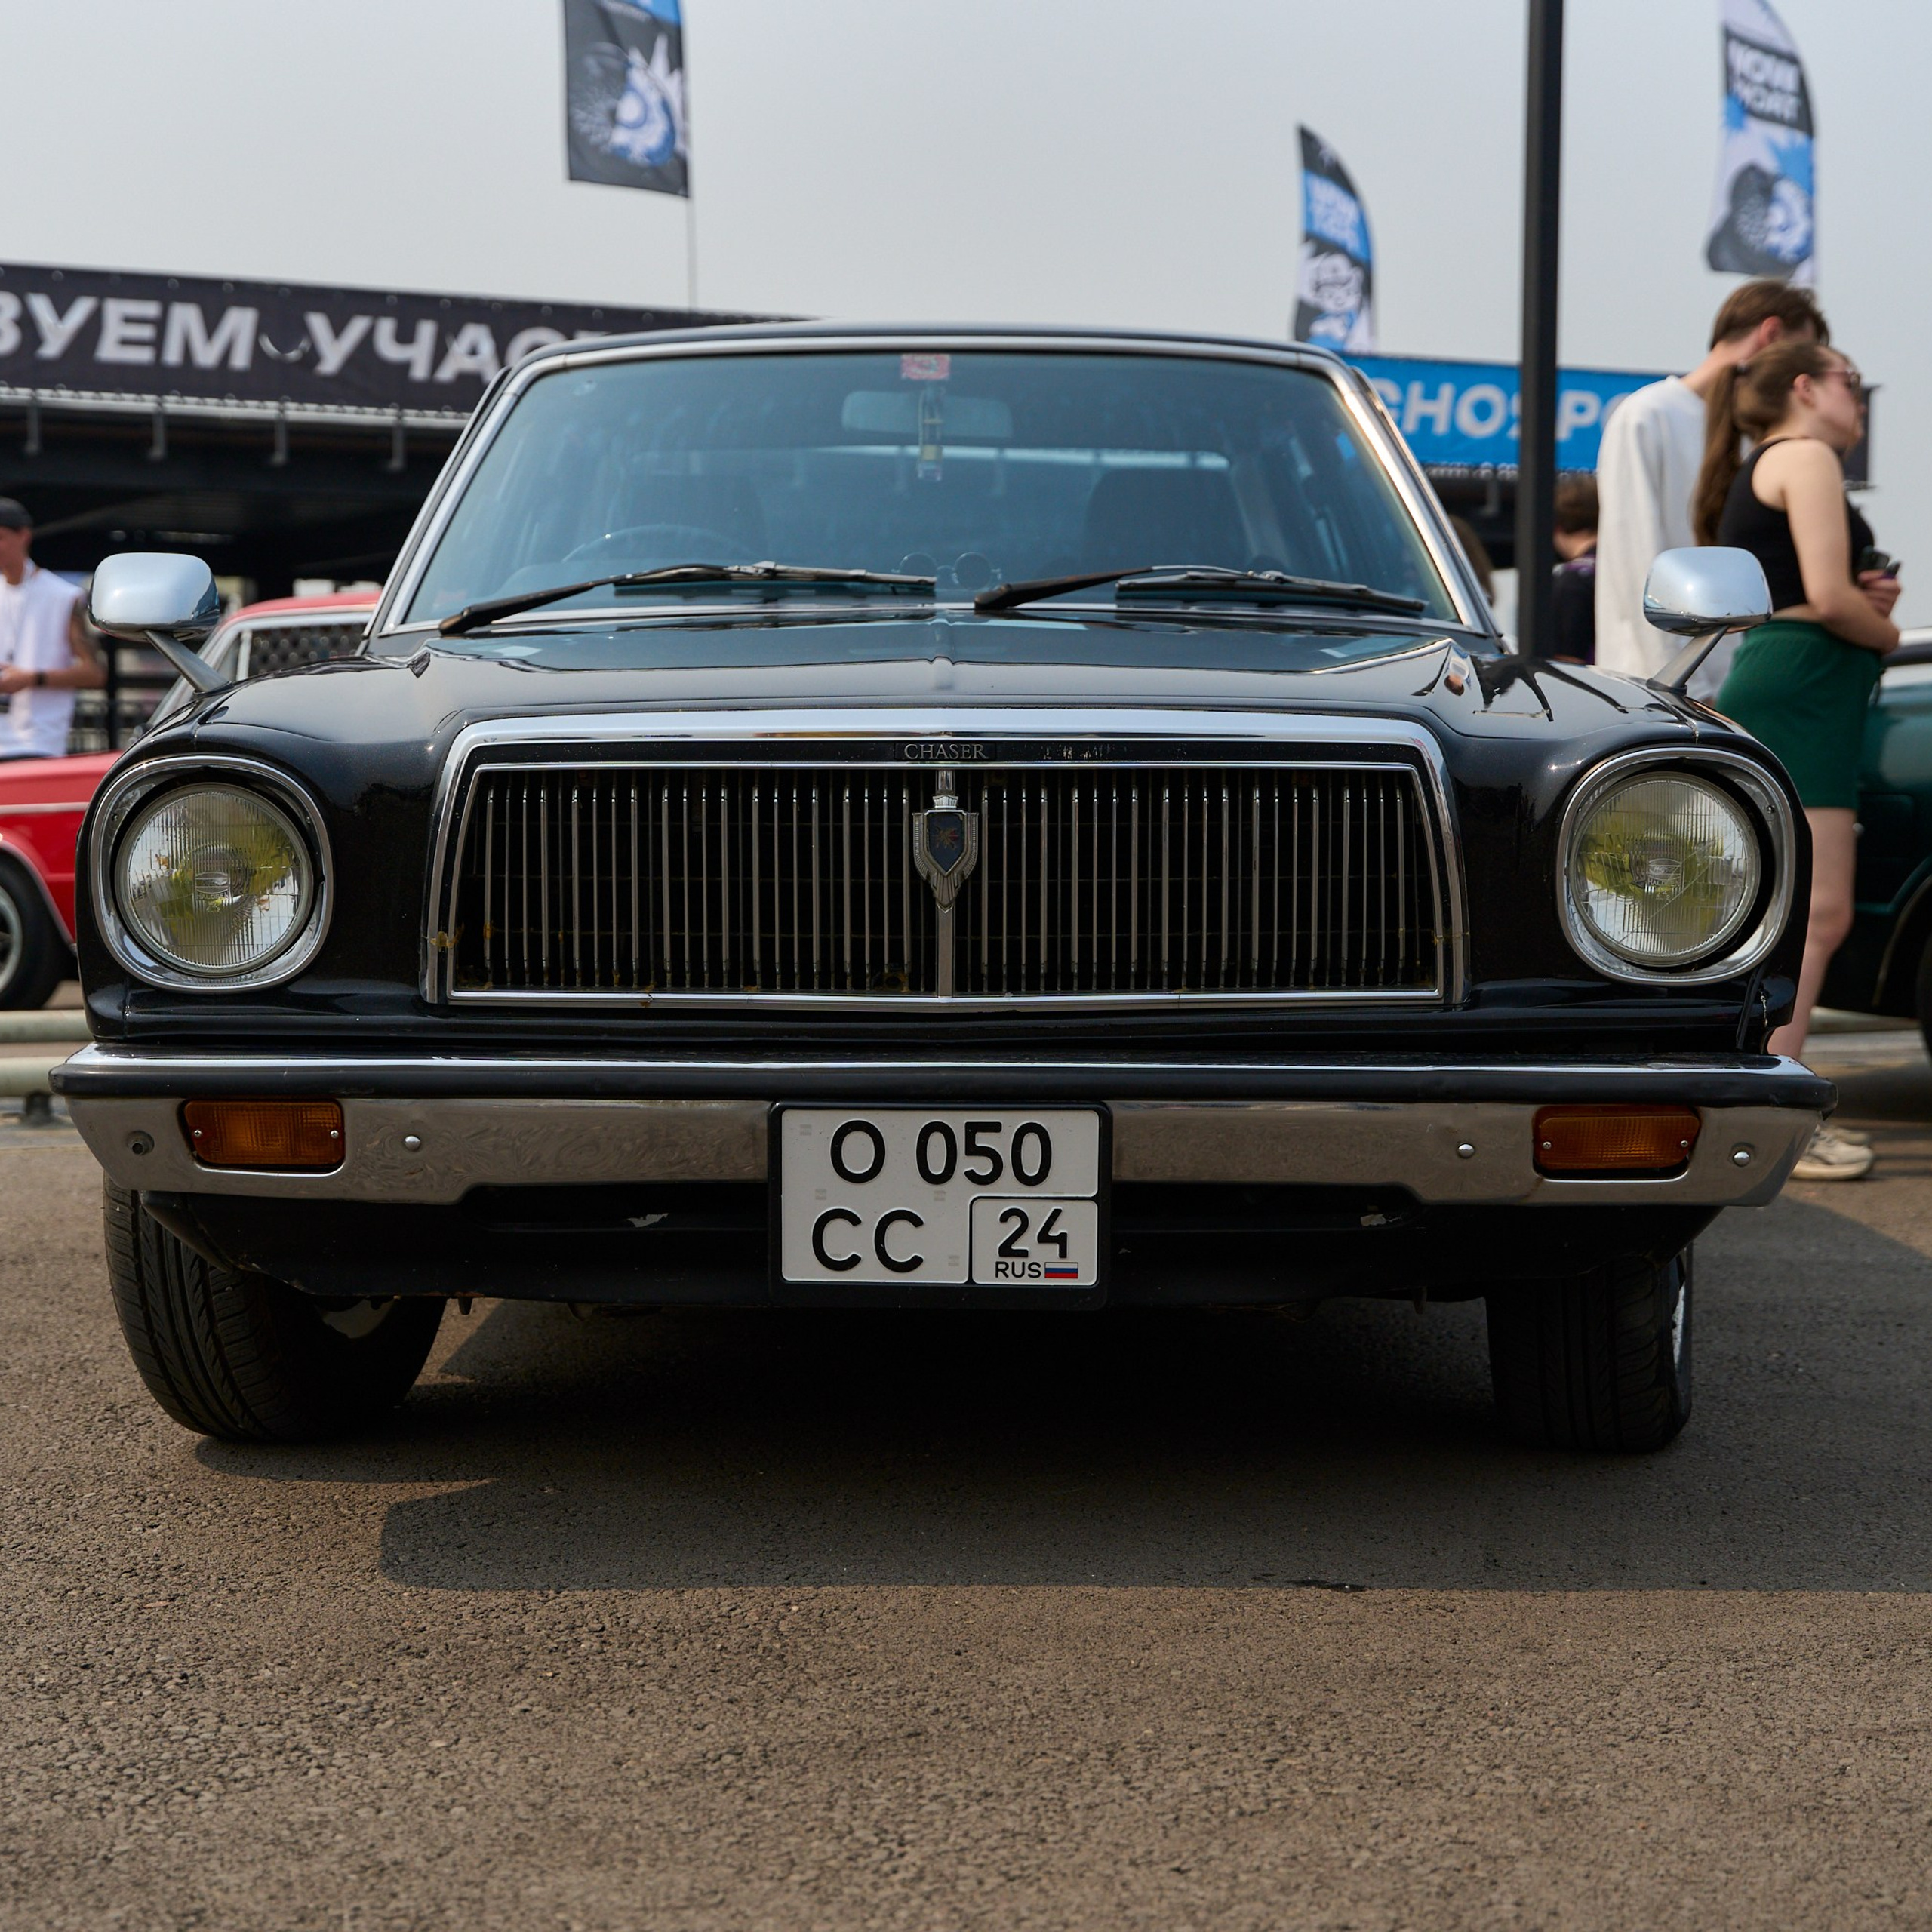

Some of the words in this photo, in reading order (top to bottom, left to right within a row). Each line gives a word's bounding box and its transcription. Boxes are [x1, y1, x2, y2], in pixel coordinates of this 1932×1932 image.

[904, 743, 989, 760] CHASER
[830, 1120, 886, 1183] O
[915, 1121, 1052, 1186] 050
[811, 1208, 924, 1273] CC
[998, 1208, 1068, 1259] 24
[995, 1262, 1041, 1278] RUS
